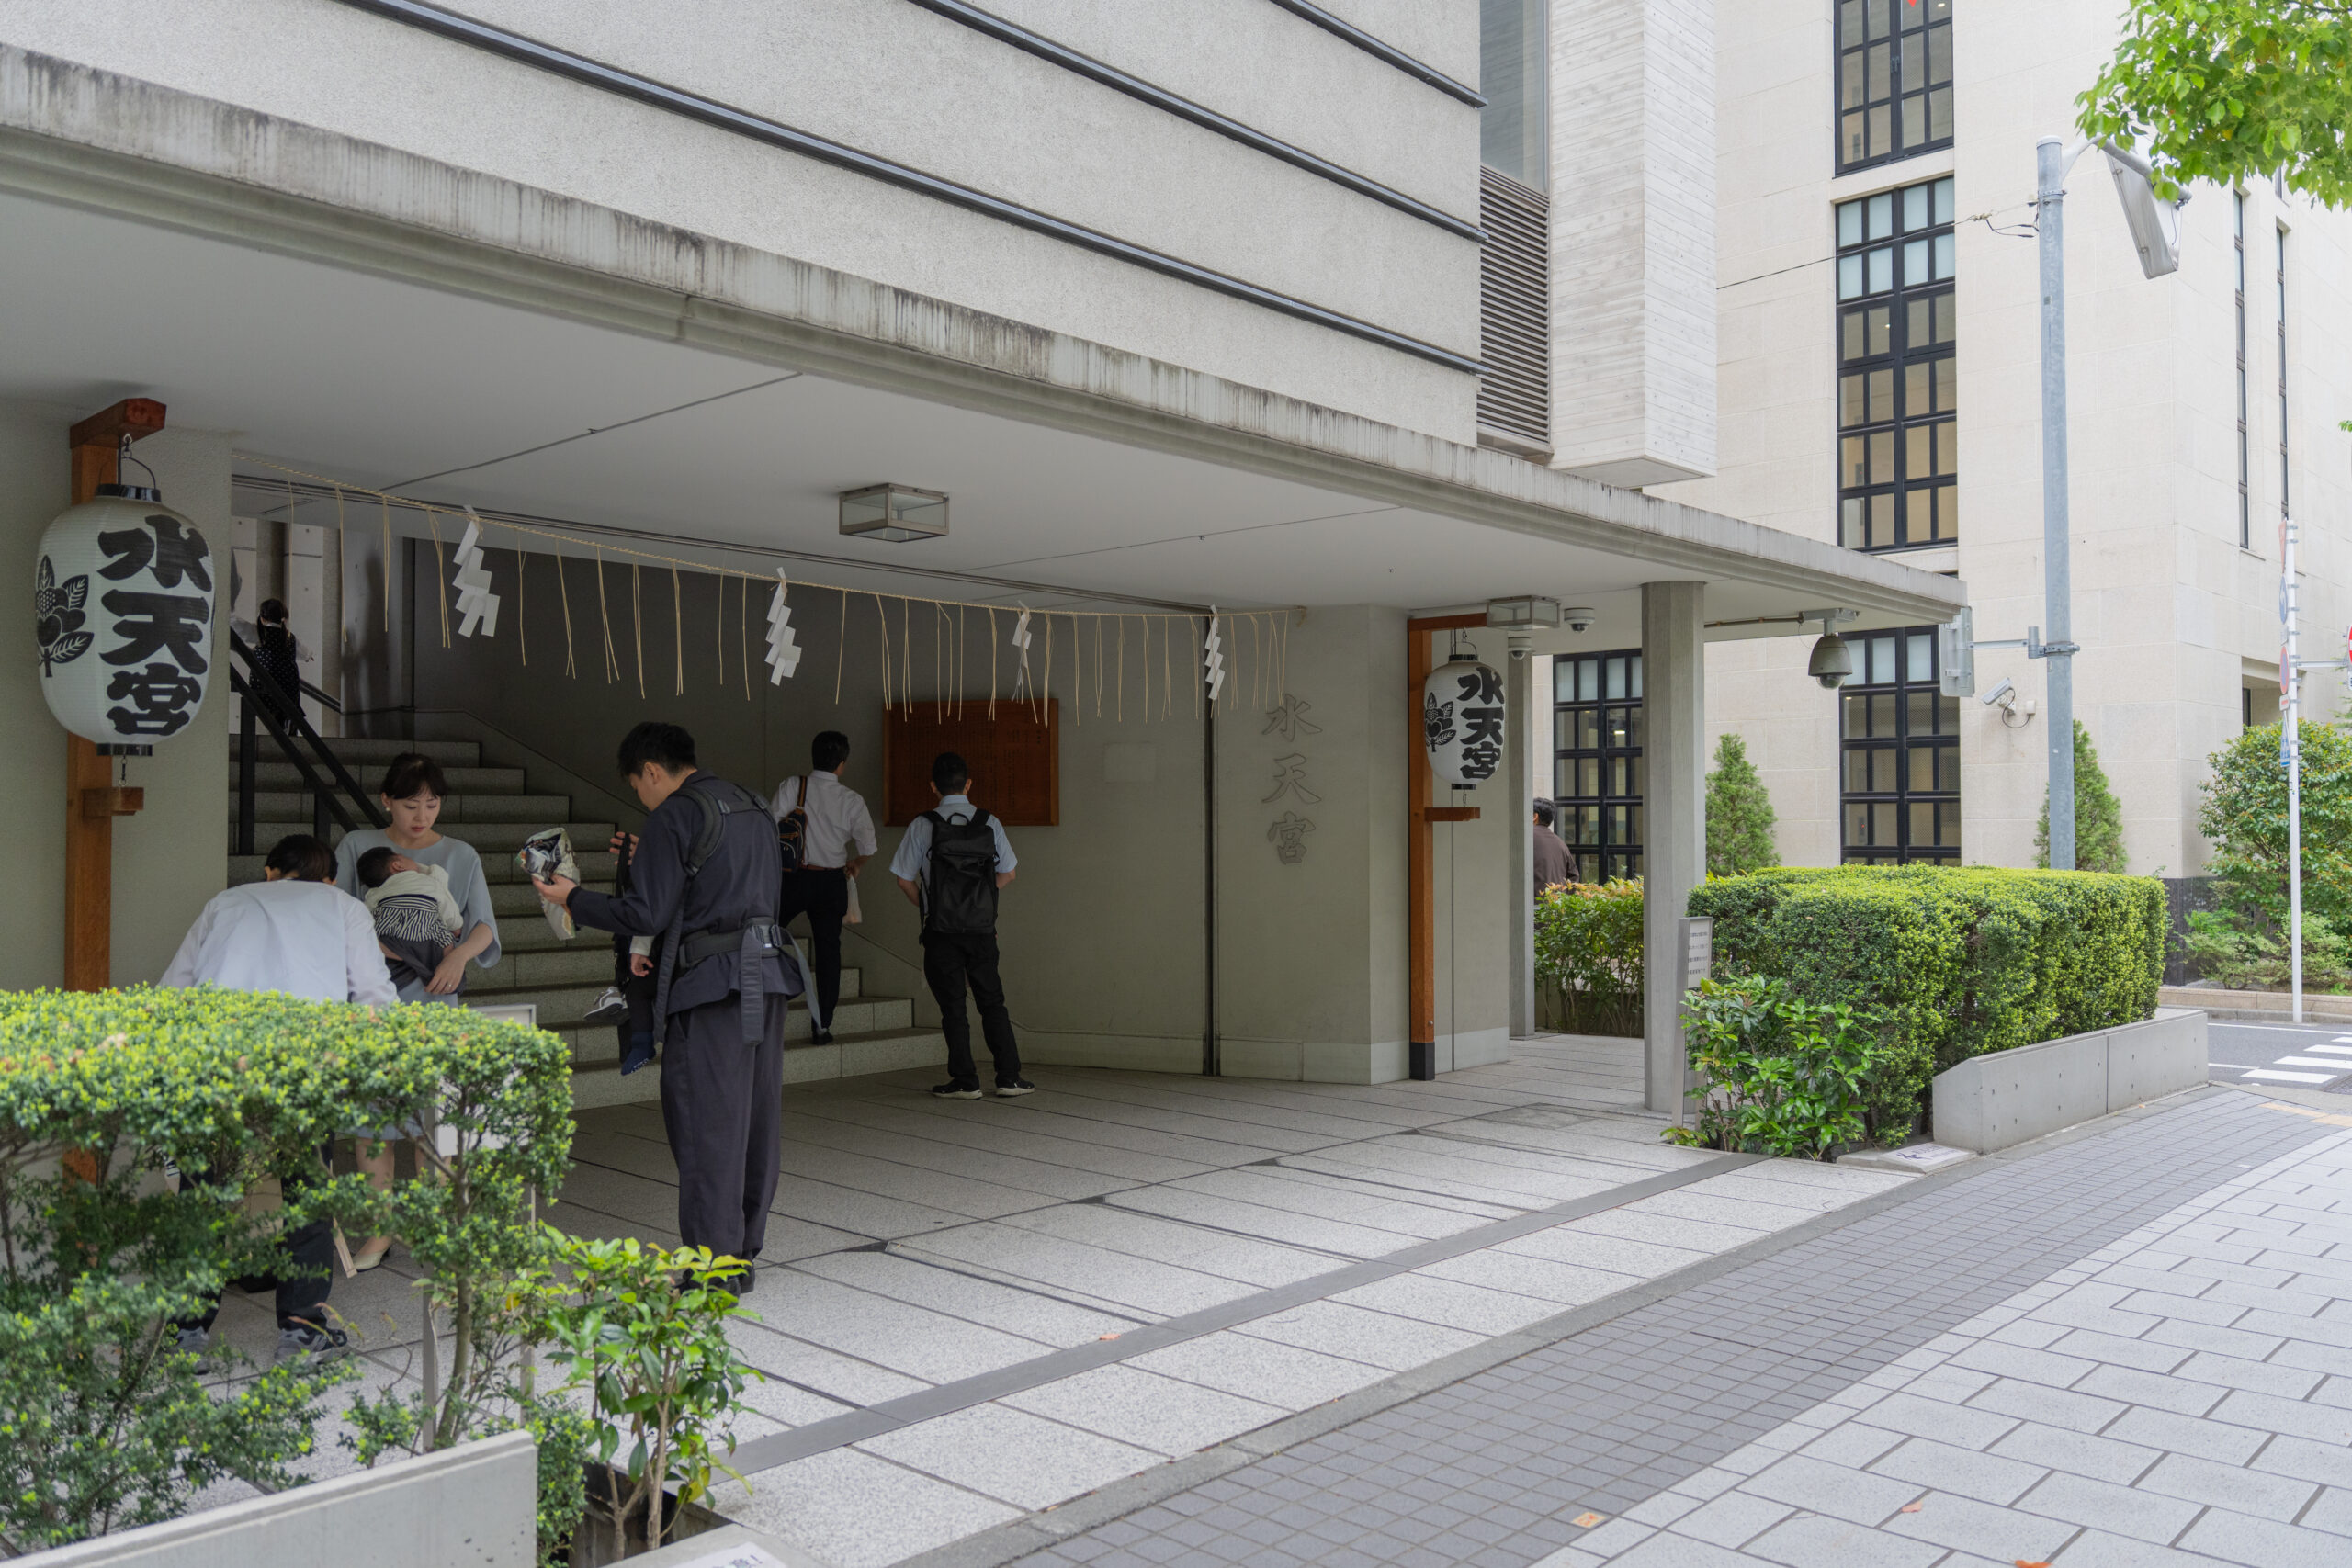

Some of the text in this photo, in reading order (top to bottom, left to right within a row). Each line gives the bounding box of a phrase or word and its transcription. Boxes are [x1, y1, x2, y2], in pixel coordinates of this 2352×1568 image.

[96, 514, 212, 736] 水天宮
[1261, 694, 1323, 865] 水天宮
[1456, 666, 1505, 780] 水天宮
